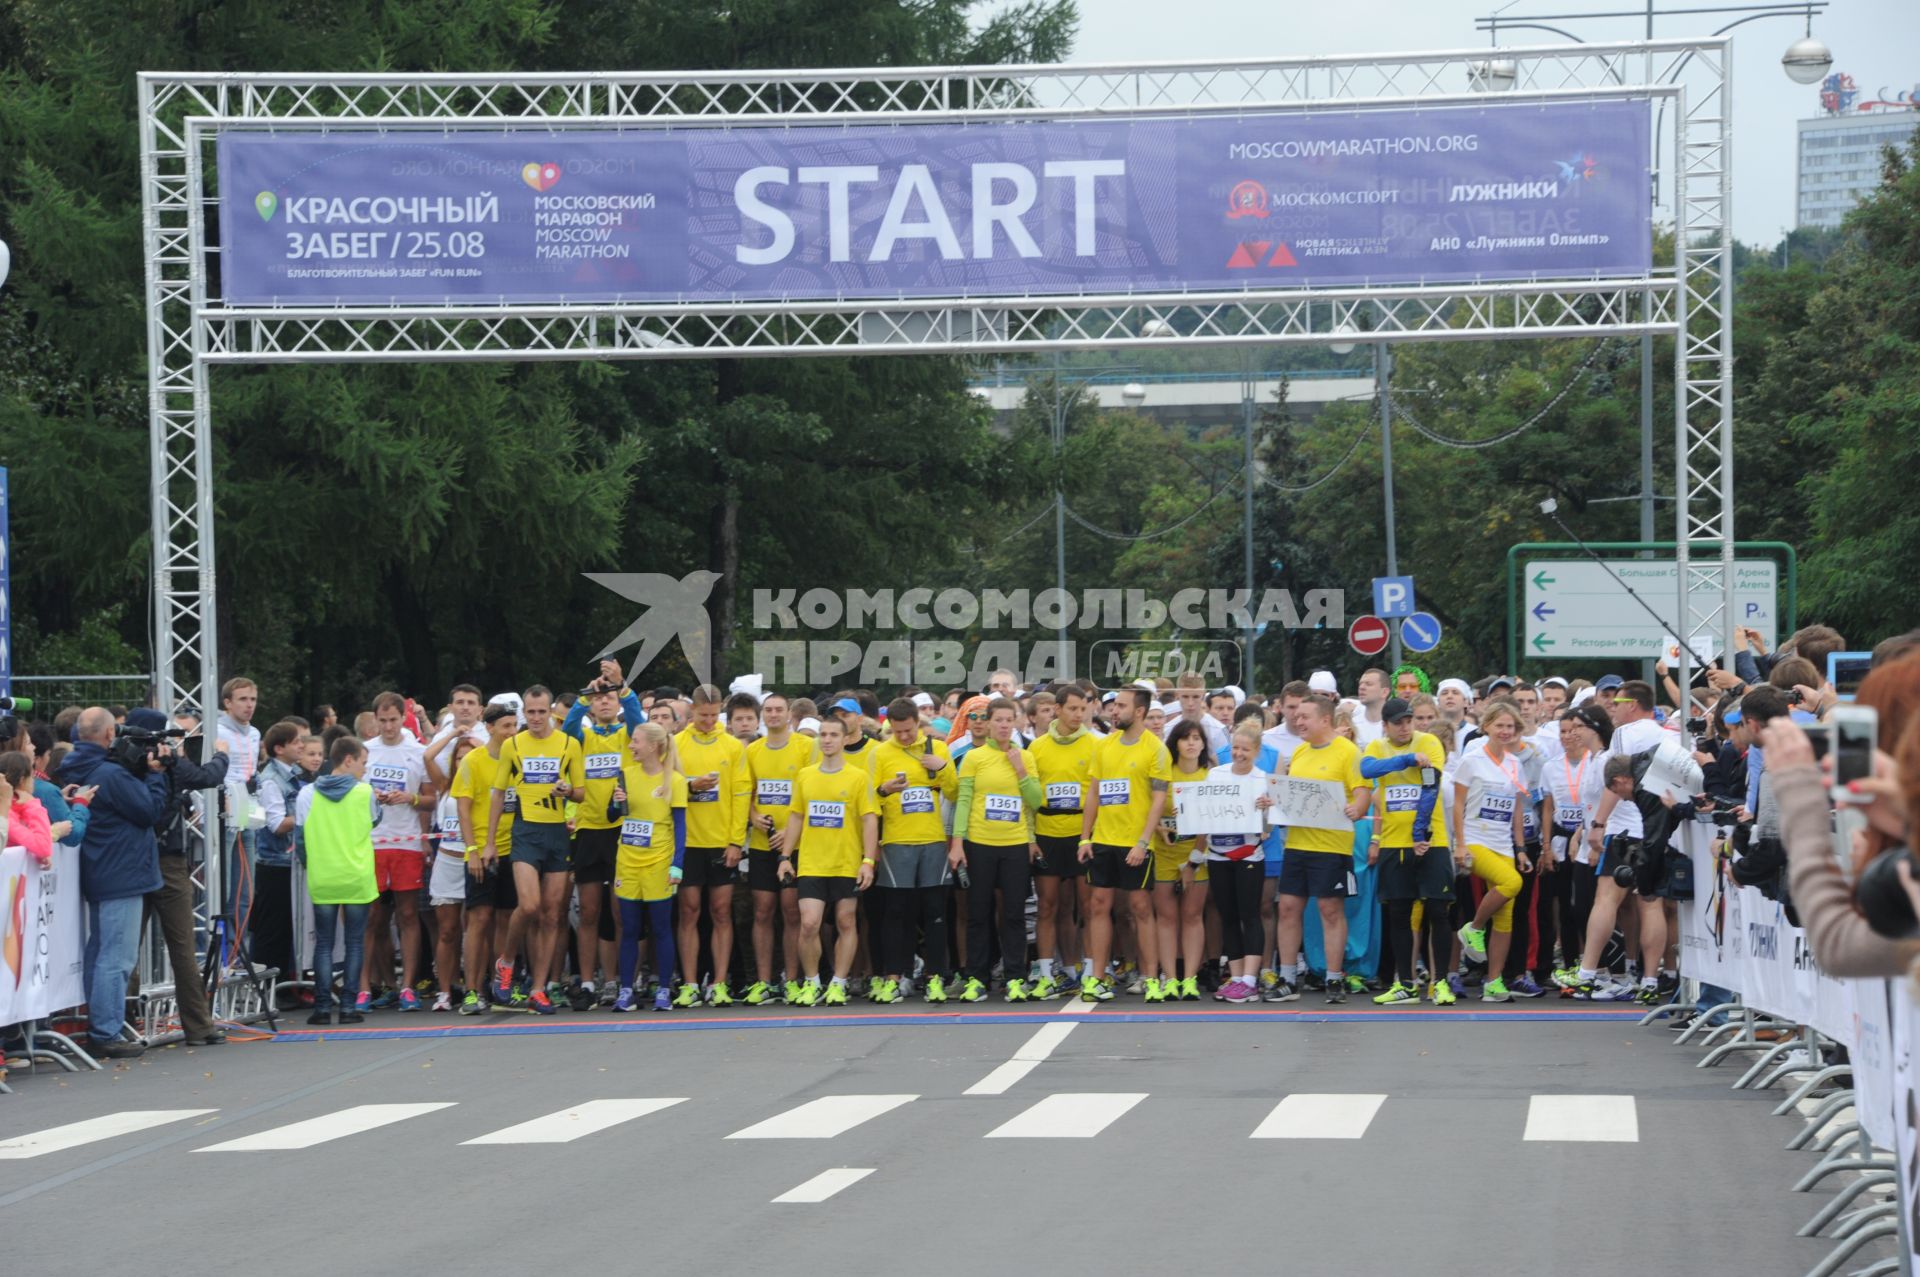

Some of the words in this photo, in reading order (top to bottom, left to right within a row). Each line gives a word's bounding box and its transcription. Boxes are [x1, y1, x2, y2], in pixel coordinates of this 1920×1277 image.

[1230, 135, 1478, 160] MOSCOWMARATHON.ORG
[1449, 182, 1558, 203] ЛУЖНИКИ
[534, 193, 656, 210] МОСКОВСКИЙ
[1273, 190, 1399, 207] МОСКОМСПОРТ
[285, 191, 499, 224] КРАСОЧНЫЙ
[734, 159, 1125, 265] START
[535, 212, 622, 226] МАРАФОН
[535, 228, 612, 242] MOSCOW
[1296, 238, 1335, 249] НОВАЯ
[1430, 237, 1460, 251] АНО
[536, 244, 630, 258] MARATHON
[1305, 246, 1360, 257] АТЛЕТИКА
[287, 267, 398, 278] БЛАГОТВОРИТЕЛЬНЫЙ
[399, 269, 427, 278] ЗАБЕГ
[1619, 568, 1667, 577] Большая
[1737, 568, 1770, 579] Арена
[1740, 580, 1770, 589] Arena
[1572, 638, 1617, 648] Ресторан
[1621, 638, 1636, 647] VIP
[1640, 638, 1663, 649] Клуб
[527, 761, 556, 771] 1362
[589, 756, 618, 767] 1359
[373, 767, 404, 780] 0529
[761, 783, 789, 793] 1354
[1048, 786, 1077, 796] 1360
[1102, 782, 1127, 793] 1353
[1197, 785, 1240, 797] ВПЕРЕД
[1289, 780, 1322, 794] ВПЕРЕД
[903, 790, 931, 801] 0524
[1388, 788, 1418, 799] 1350
[990, 798, 1017, 809] 1361
[1486, 798, 1512, 809] 1149
[813, 804, 841, 815] 1040
[446, 820, 460, 830] 07
[625, 823, 649, 834] 1358
